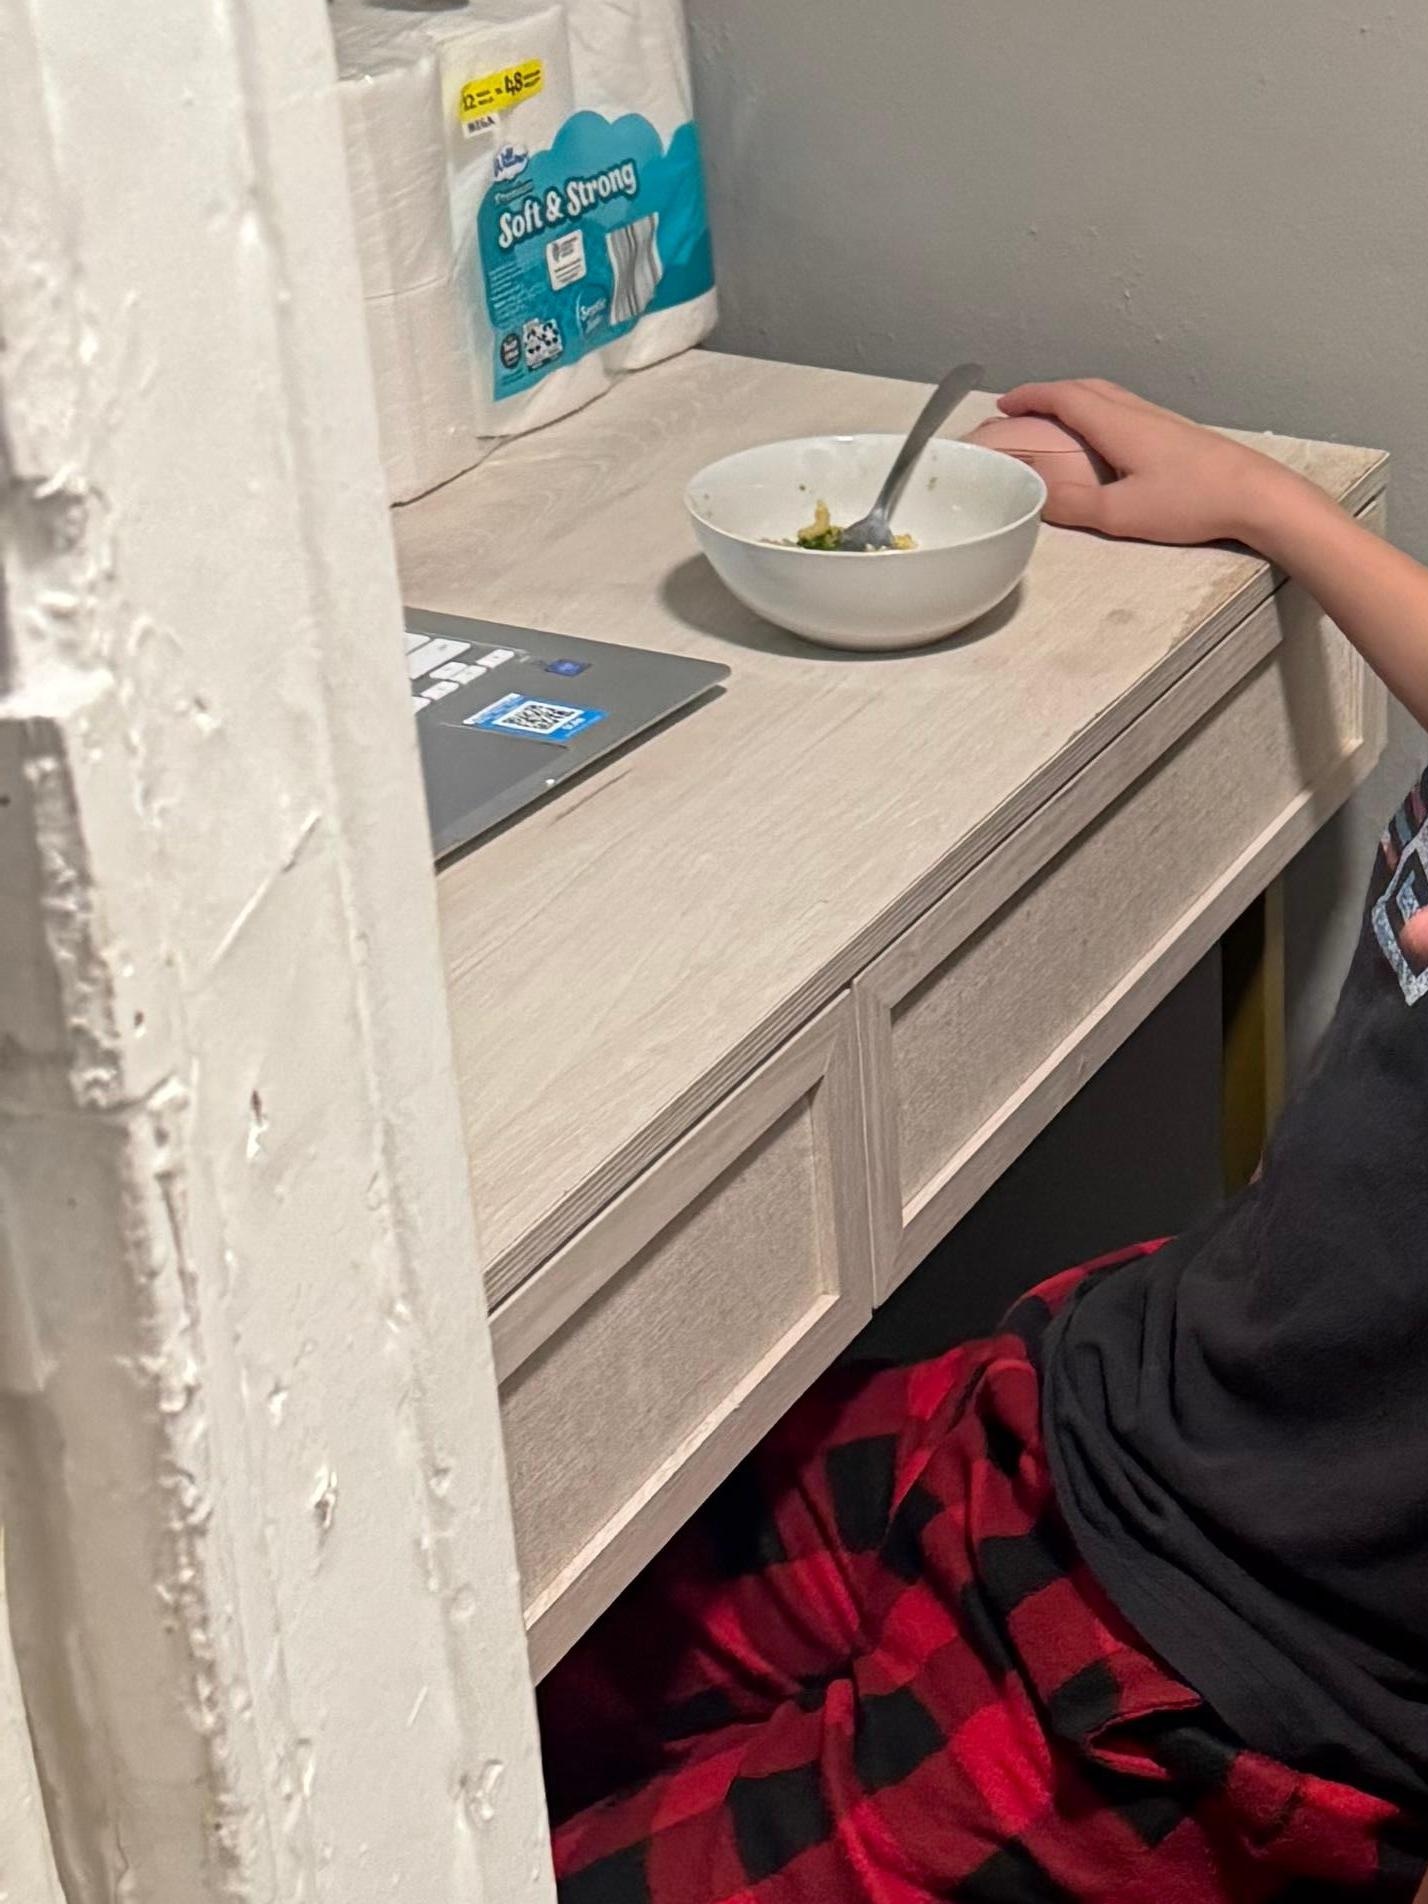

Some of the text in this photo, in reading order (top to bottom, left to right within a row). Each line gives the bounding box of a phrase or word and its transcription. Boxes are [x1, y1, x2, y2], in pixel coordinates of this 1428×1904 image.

[505, 72, 524, 96] 48
[498, 199, 544, 249] Soft
[546, 190, 564, 222] &
[567, 160, 638, 217] Strong
